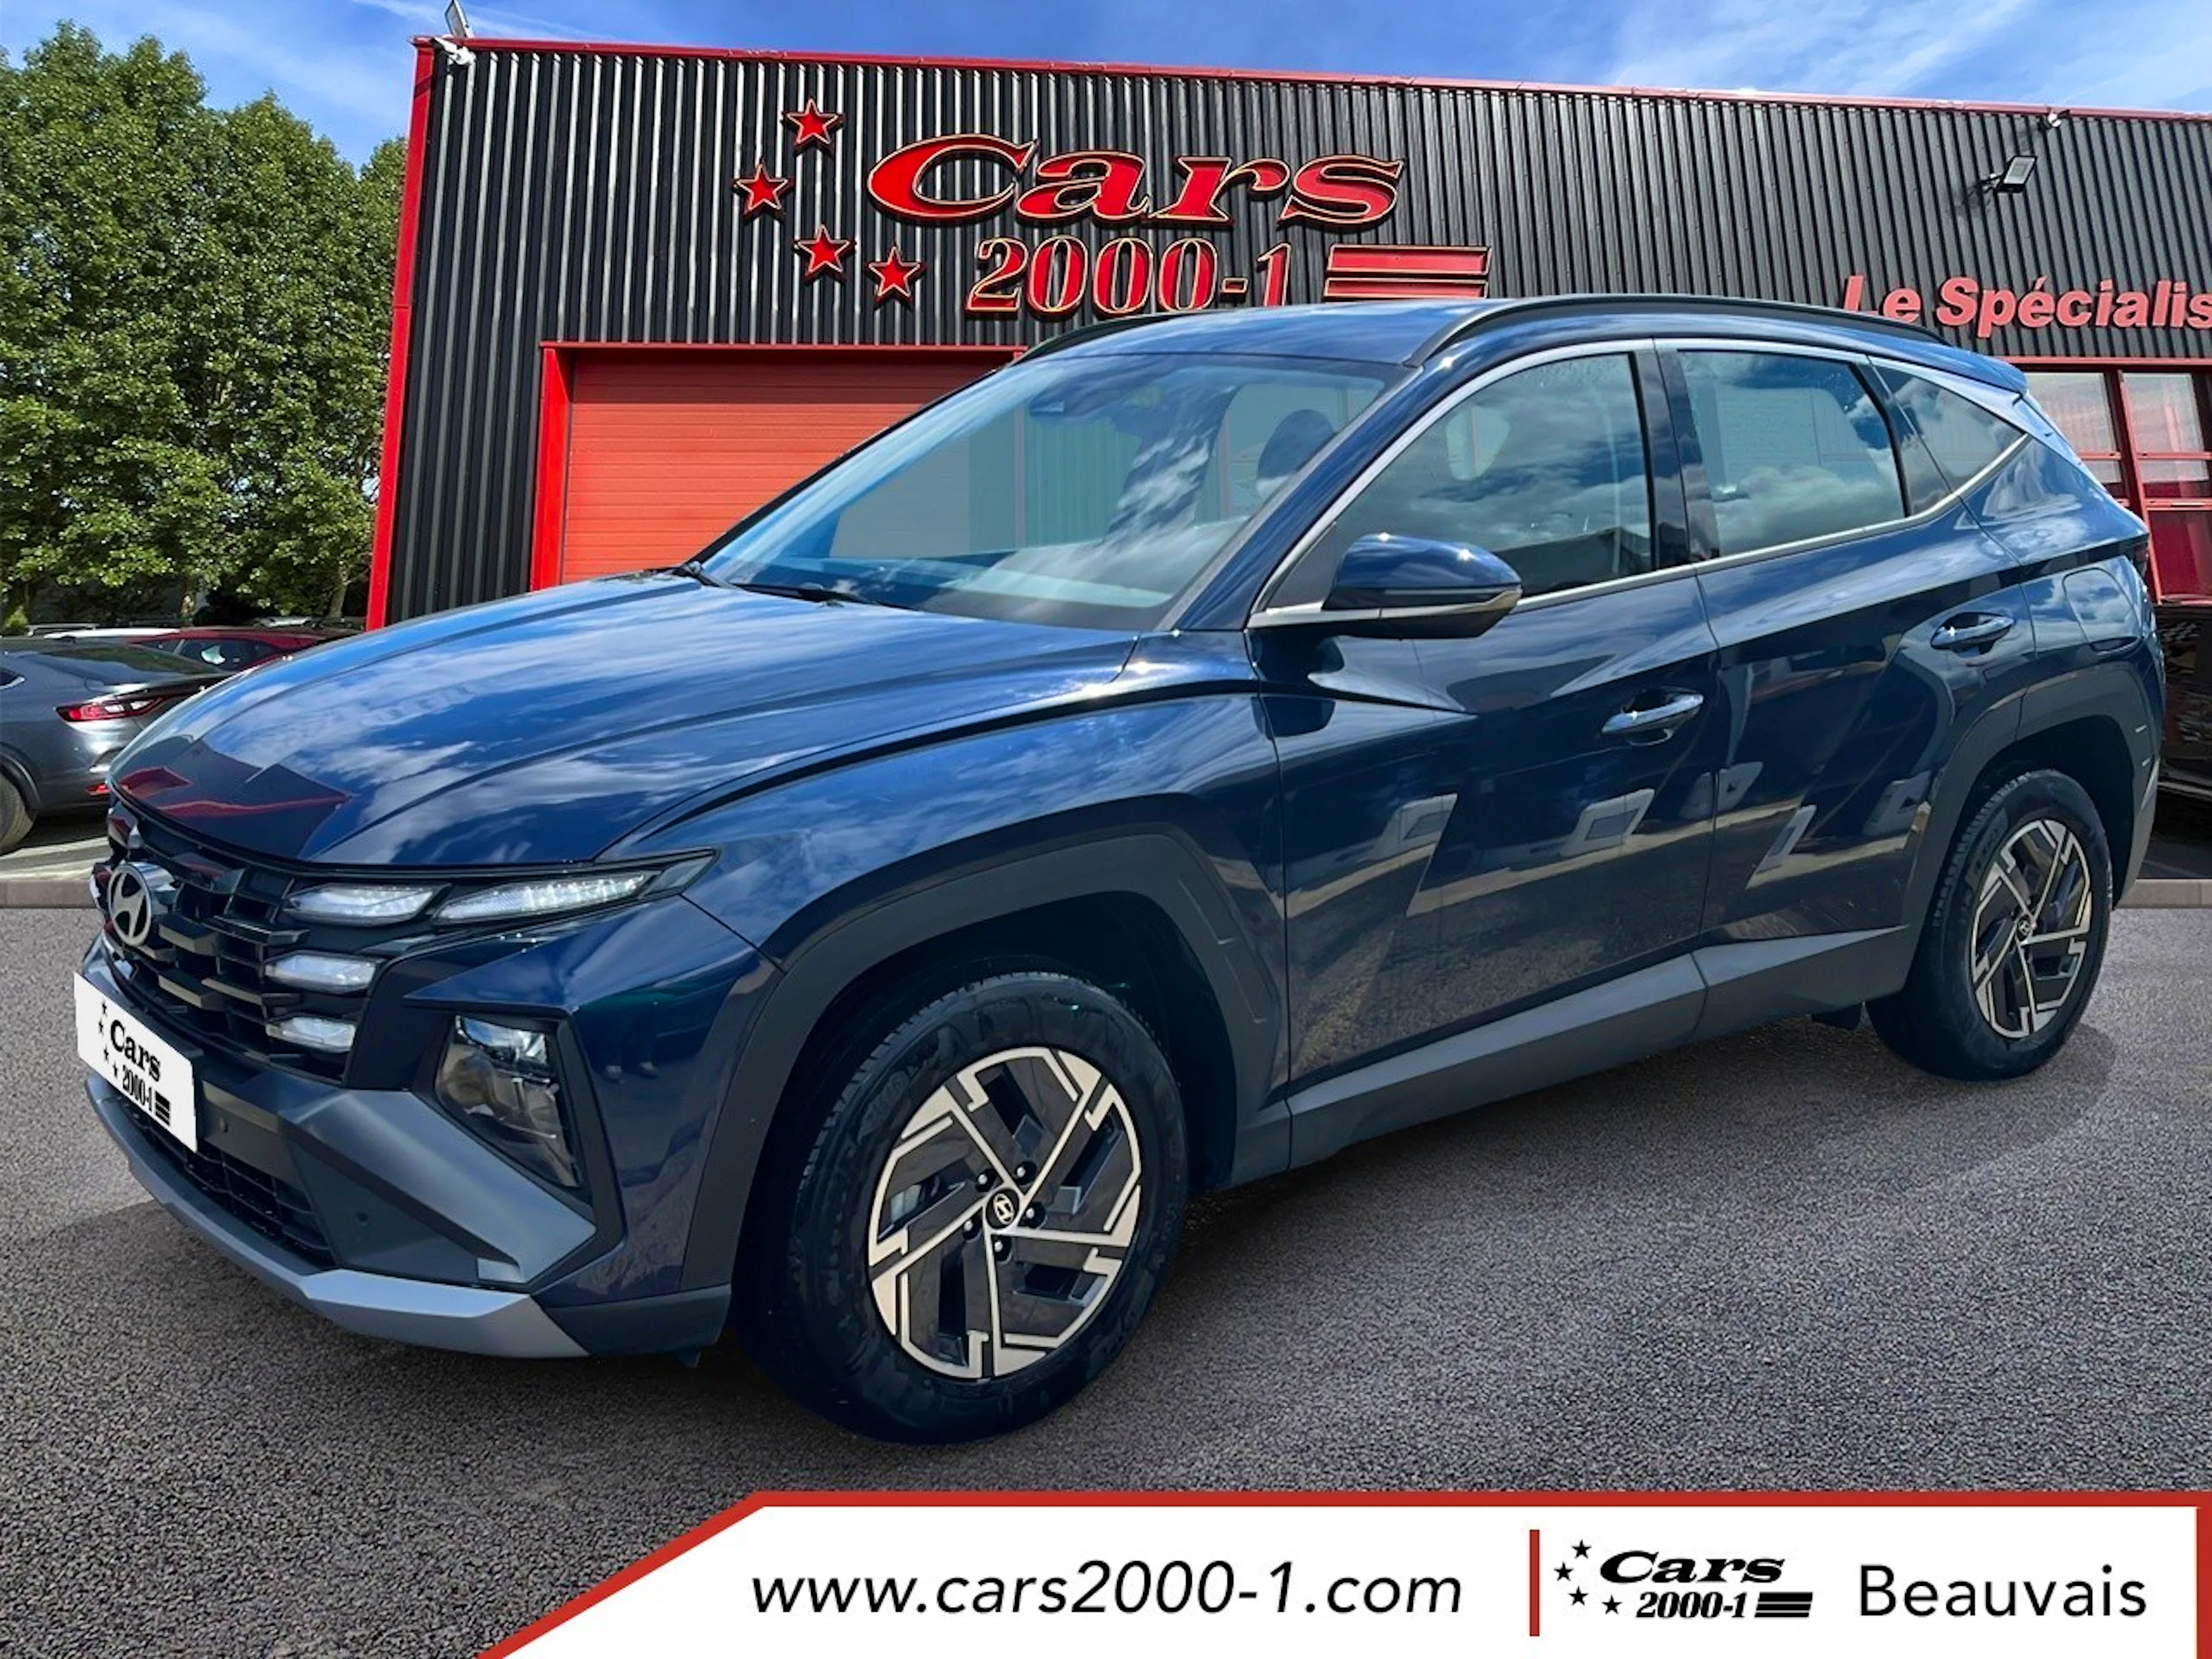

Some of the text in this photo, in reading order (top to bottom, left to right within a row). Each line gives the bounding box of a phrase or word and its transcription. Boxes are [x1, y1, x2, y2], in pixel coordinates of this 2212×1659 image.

[866, 132, 1403, 229] Cars
[965, 236, 1291, 314] 2000-1
[1844, 275, 2212, 338] Le Spécialis
[111, 1019, 161, 1082] Cars
